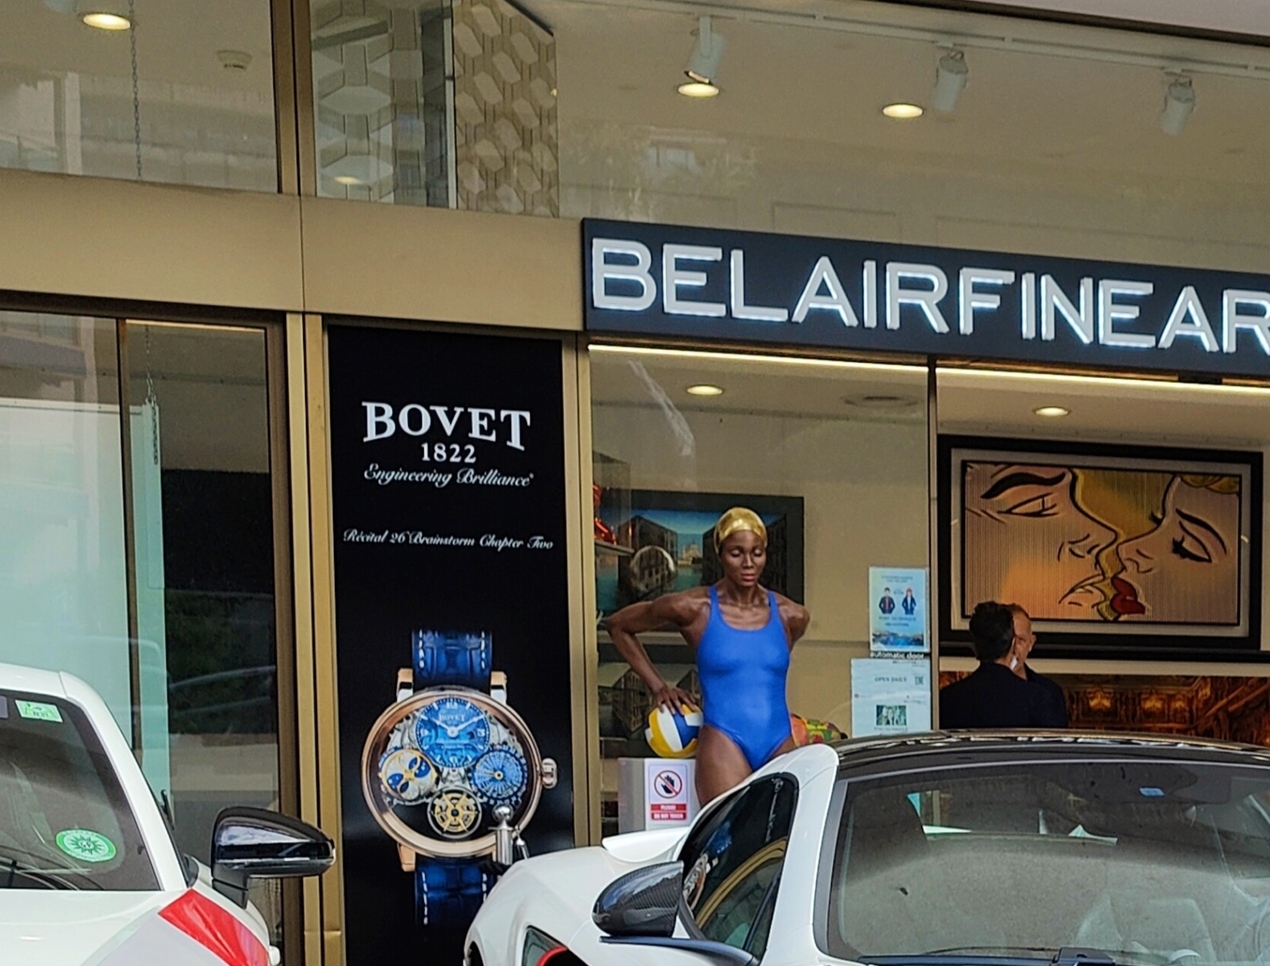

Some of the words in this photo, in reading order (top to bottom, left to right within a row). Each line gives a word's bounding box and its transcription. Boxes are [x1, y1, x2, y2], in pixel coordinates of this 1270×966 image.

[361, 401, 531, 451] BOVET
[421, 442, 477, 463] 1822
[363, 463, 453, 488] Engineering
[343, 528, 389, 544] Récital
[389, 530, 406, 544] 26
[408, 530, 475, 547] Brainstorm
[479, 534, 524, 552] Chapter
[527, 535, 554, 550] Two
